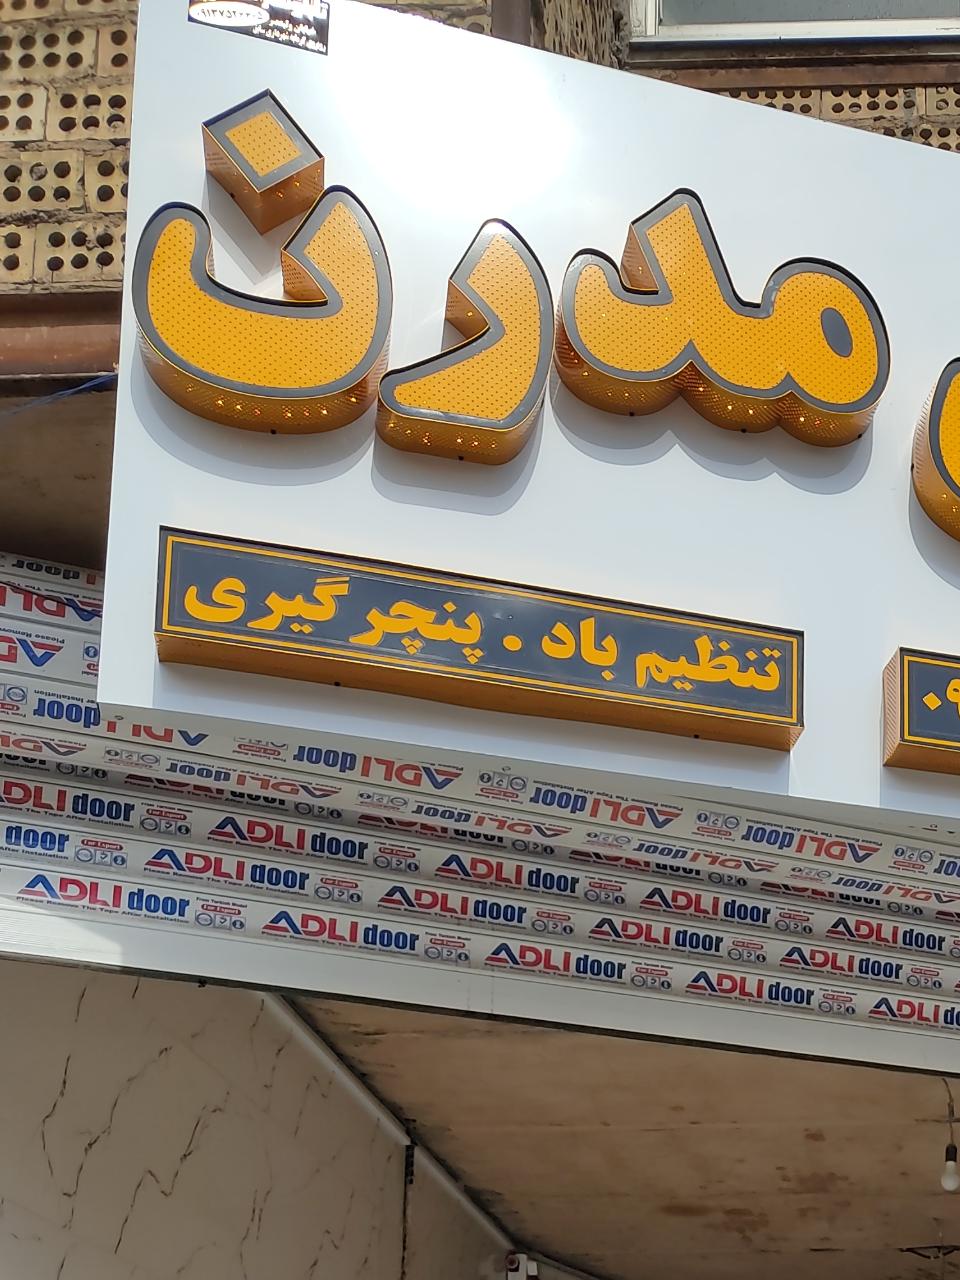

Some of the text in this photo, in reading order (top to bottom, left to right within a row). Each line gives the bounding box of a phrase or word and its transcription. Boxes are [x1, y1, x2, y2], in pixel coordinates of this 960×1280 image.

[132, 89, 890, 455] مدرن
[0, 627, 32, 638] Remov
[184, 576, 782, 692] تنظیم باد پنچر گیری
[0, 636, 63, 667] AD
[33, 697, 100, 728] door
[0, 735, 86, 756] ADL
[166, 760, 232, 782] door
[295, 744, 464, 790] ADLI door
[0, 780, 135, 821] DLI door
[236, 774, 344, 799] ADLI
[411, 802, 472, 823] door
[529, 785, 684, 829] ADLI door
[5, 824, 69, 852] door
[208, 816, 368, 859] ADLI door
[475, 815, 573, 839] ADLI
[741, 824, 883, 864] ADLI door
[633, 841, 690, 860] door
[689, 852, 777, 873] ADLI
[144, 848, 309, 891] ADLI door
[434, 854, 580, 894] ADLI door
[832, 876, 883, 893] door
[17, 874, 190, 918] ADLI door
[377, 886, 527, 924] ADLI door
[639, 887, 771, 924] ADLI door
[261, 911, 420, 951] ADLI door
[589, 918, 723, 952] ADLI door
[826, 917, 946, 951] ADLI door
[484, 943, 627, 980] ADLI door
[779, 946, 903, 979] ADLI door
[685, 971, 815, 1005] ADLI door
[869, 997, 939, 1023] ADLI
